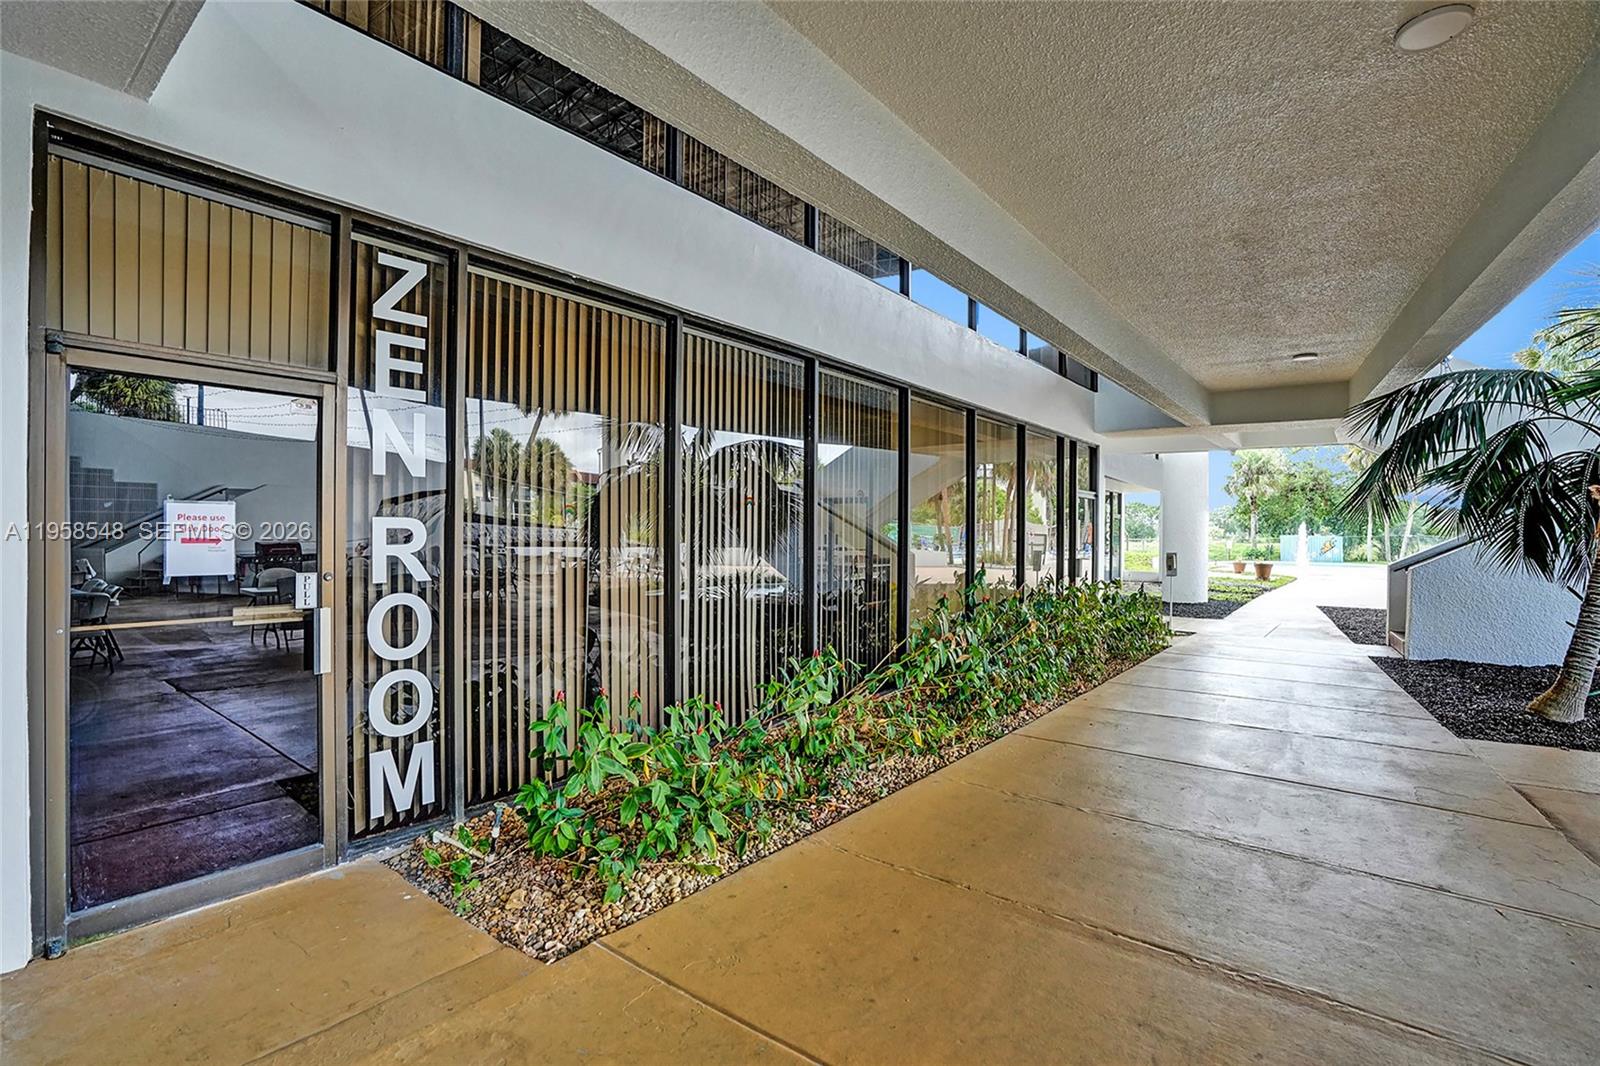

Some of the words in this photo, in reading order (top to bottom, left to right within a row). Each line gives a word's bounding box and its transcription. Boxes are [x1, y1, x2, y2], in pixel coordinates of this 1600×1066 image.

[372, 251, 428, 478] ZEN
[177, 513, 208, 521] Please
[303, 575, 311, 606] PULL
[366, 516, 436, 820] ROOM
